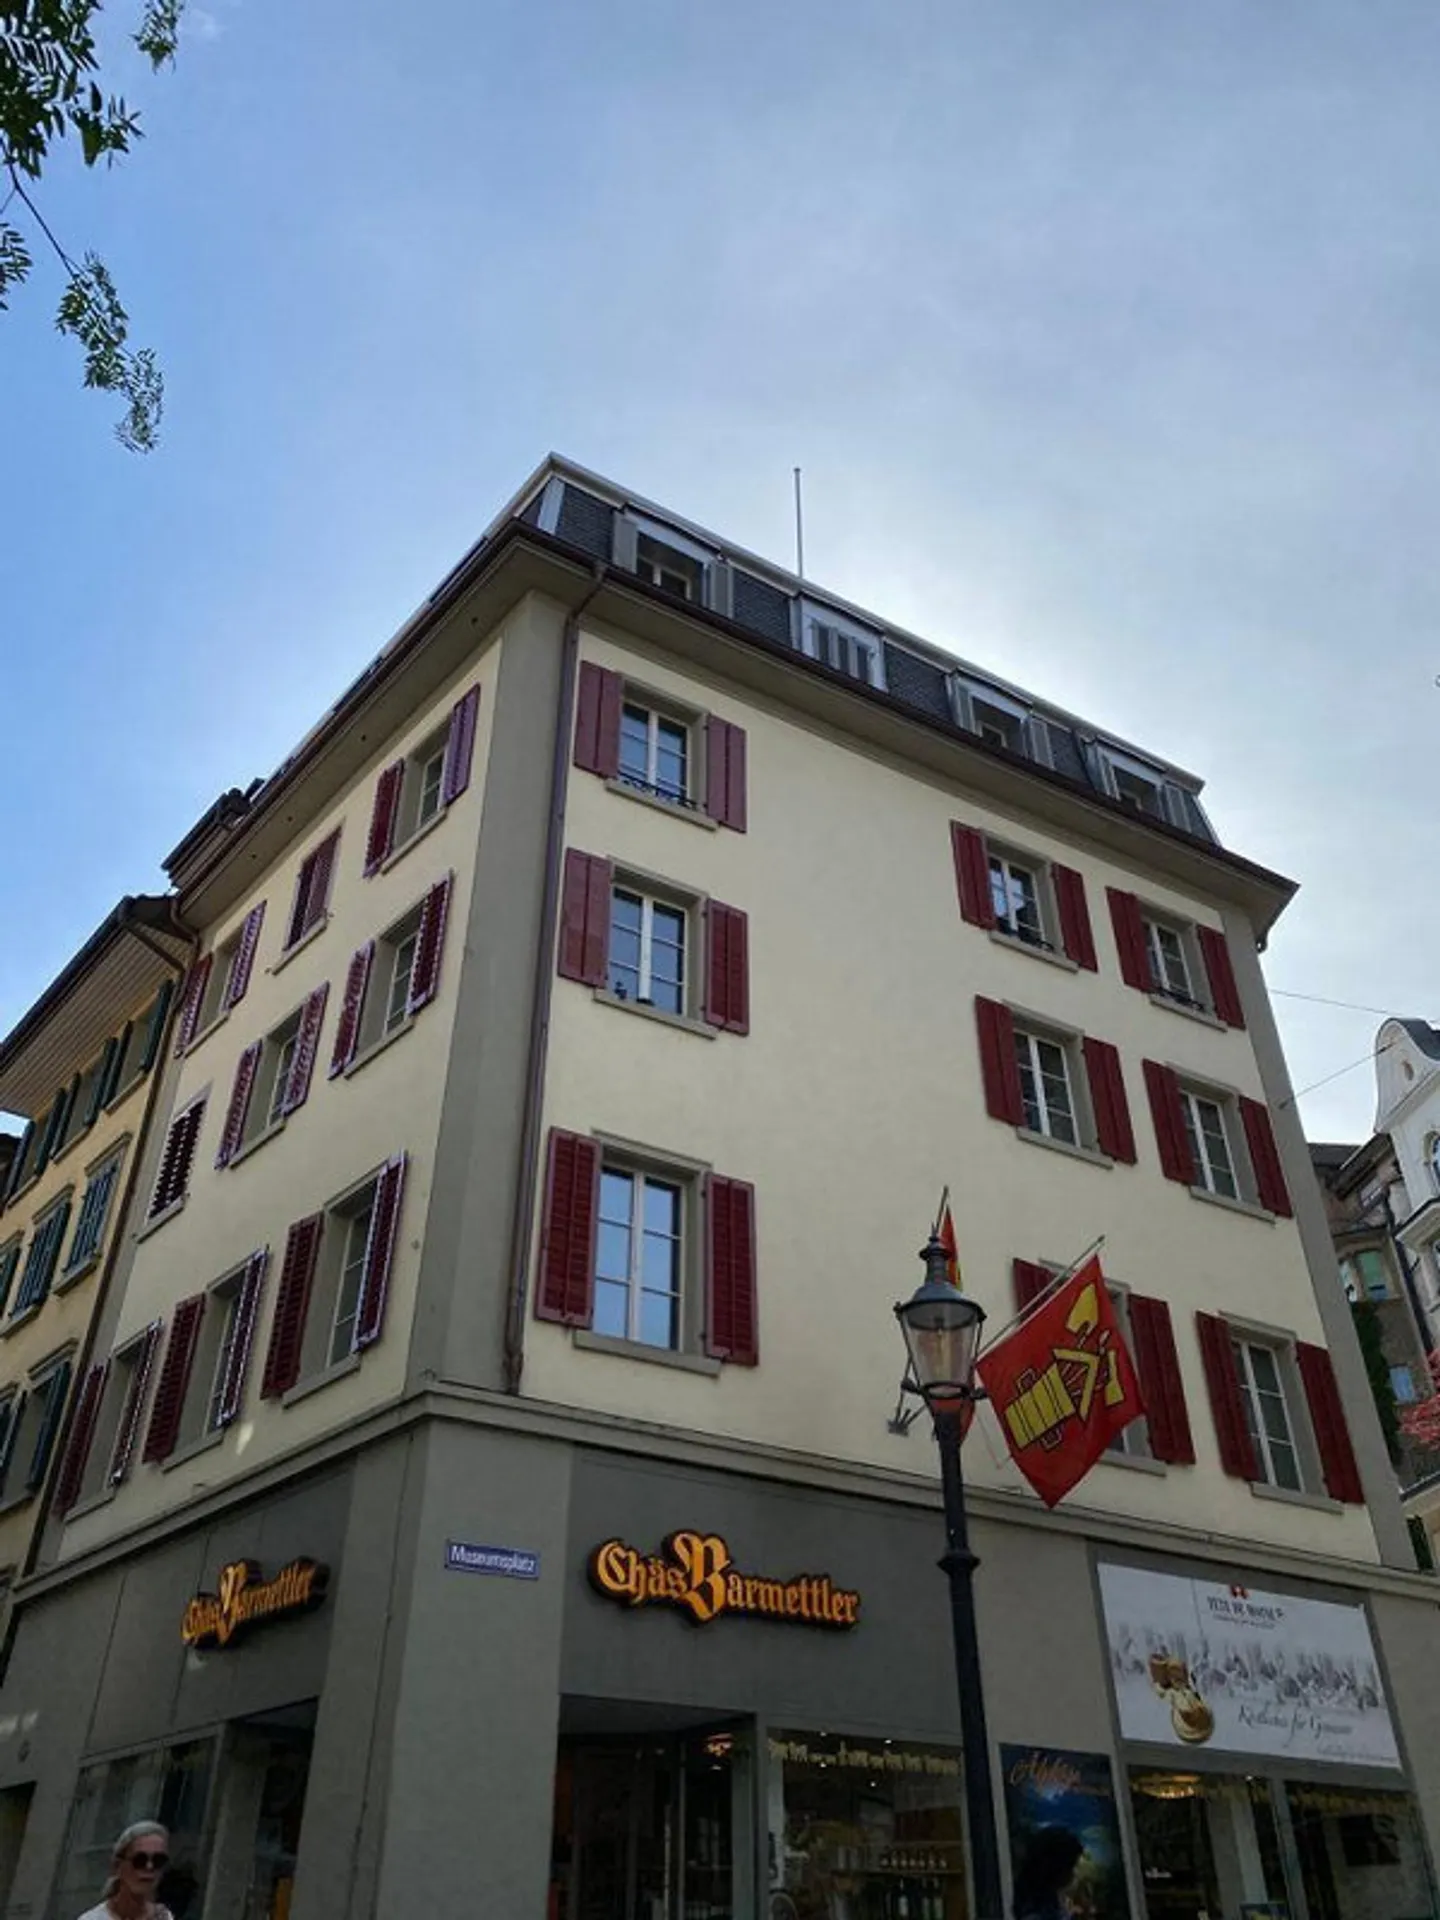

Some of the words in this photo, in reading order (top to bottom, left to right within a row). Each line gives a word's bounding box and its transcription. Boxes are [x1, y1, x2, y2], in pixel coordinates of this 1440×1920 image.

[451, 1545, 535, 1573] Museumsplatz
[597, 1541, 688, 1605] Chäs
[674, 1533, 858, 1624] Barmettler
